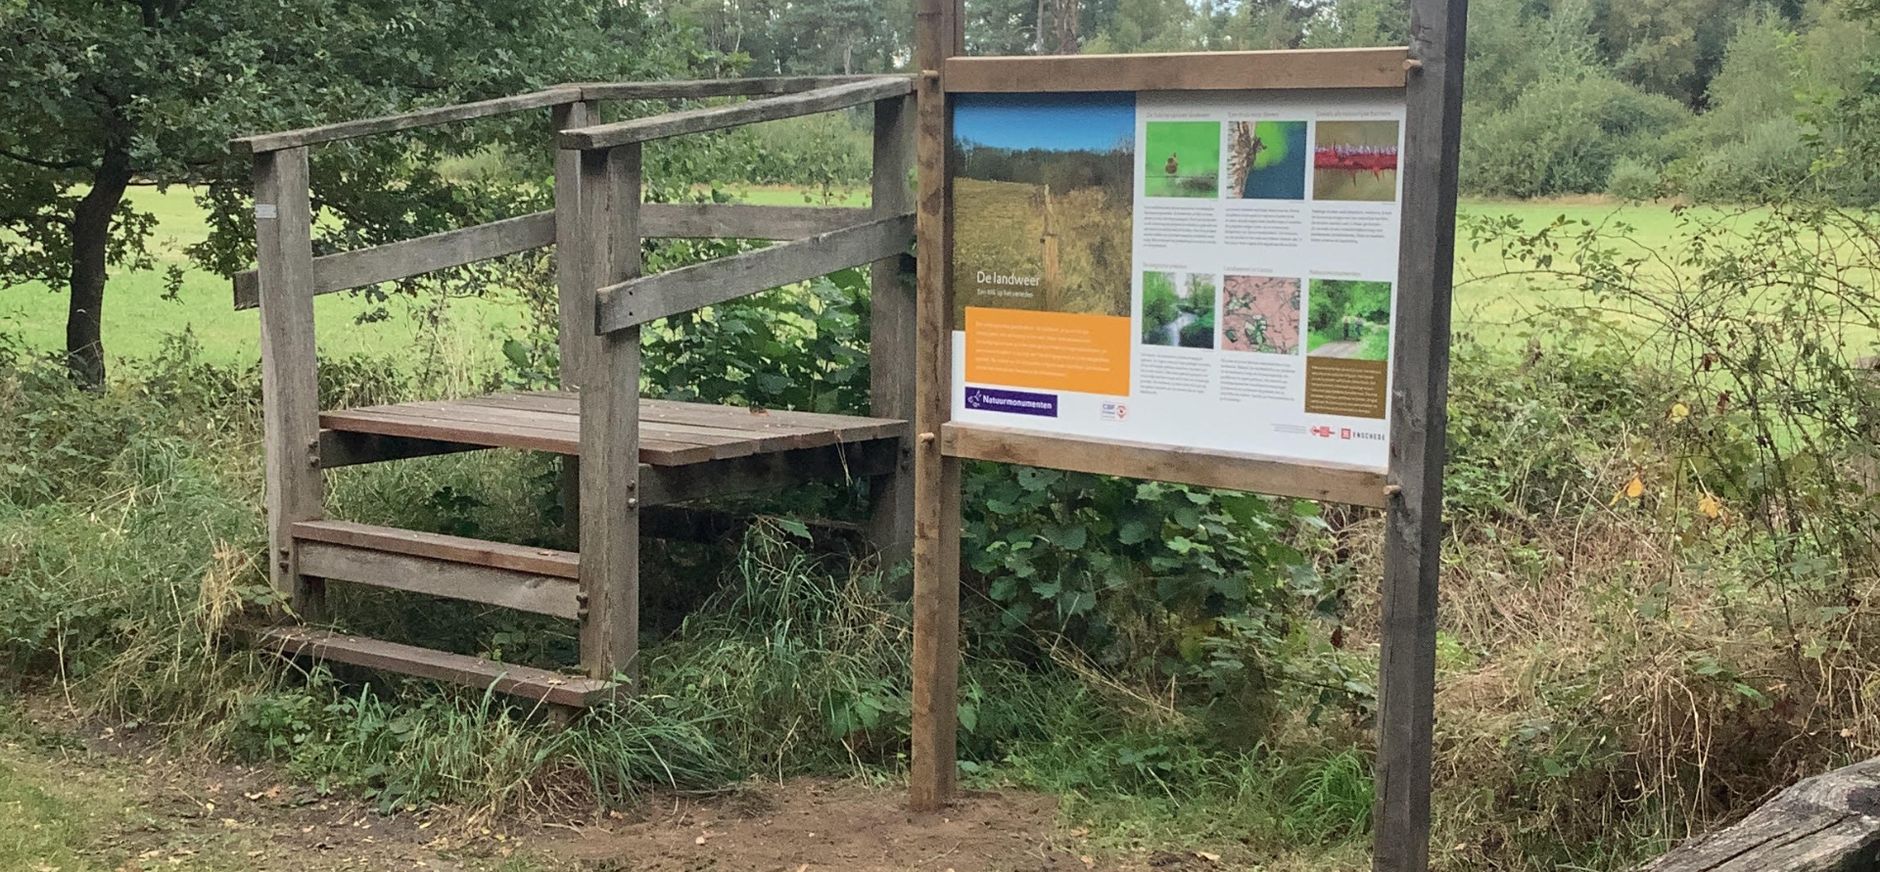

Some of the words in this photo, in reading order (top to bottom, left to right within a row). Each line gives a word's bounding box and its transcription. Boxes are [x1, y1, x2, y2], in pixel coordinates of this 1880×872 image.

[977, 271, 992, 284] De
[993, 271, 1040, 286] landweer
[982, 394, 1053, 409] Natuurmonumenten
